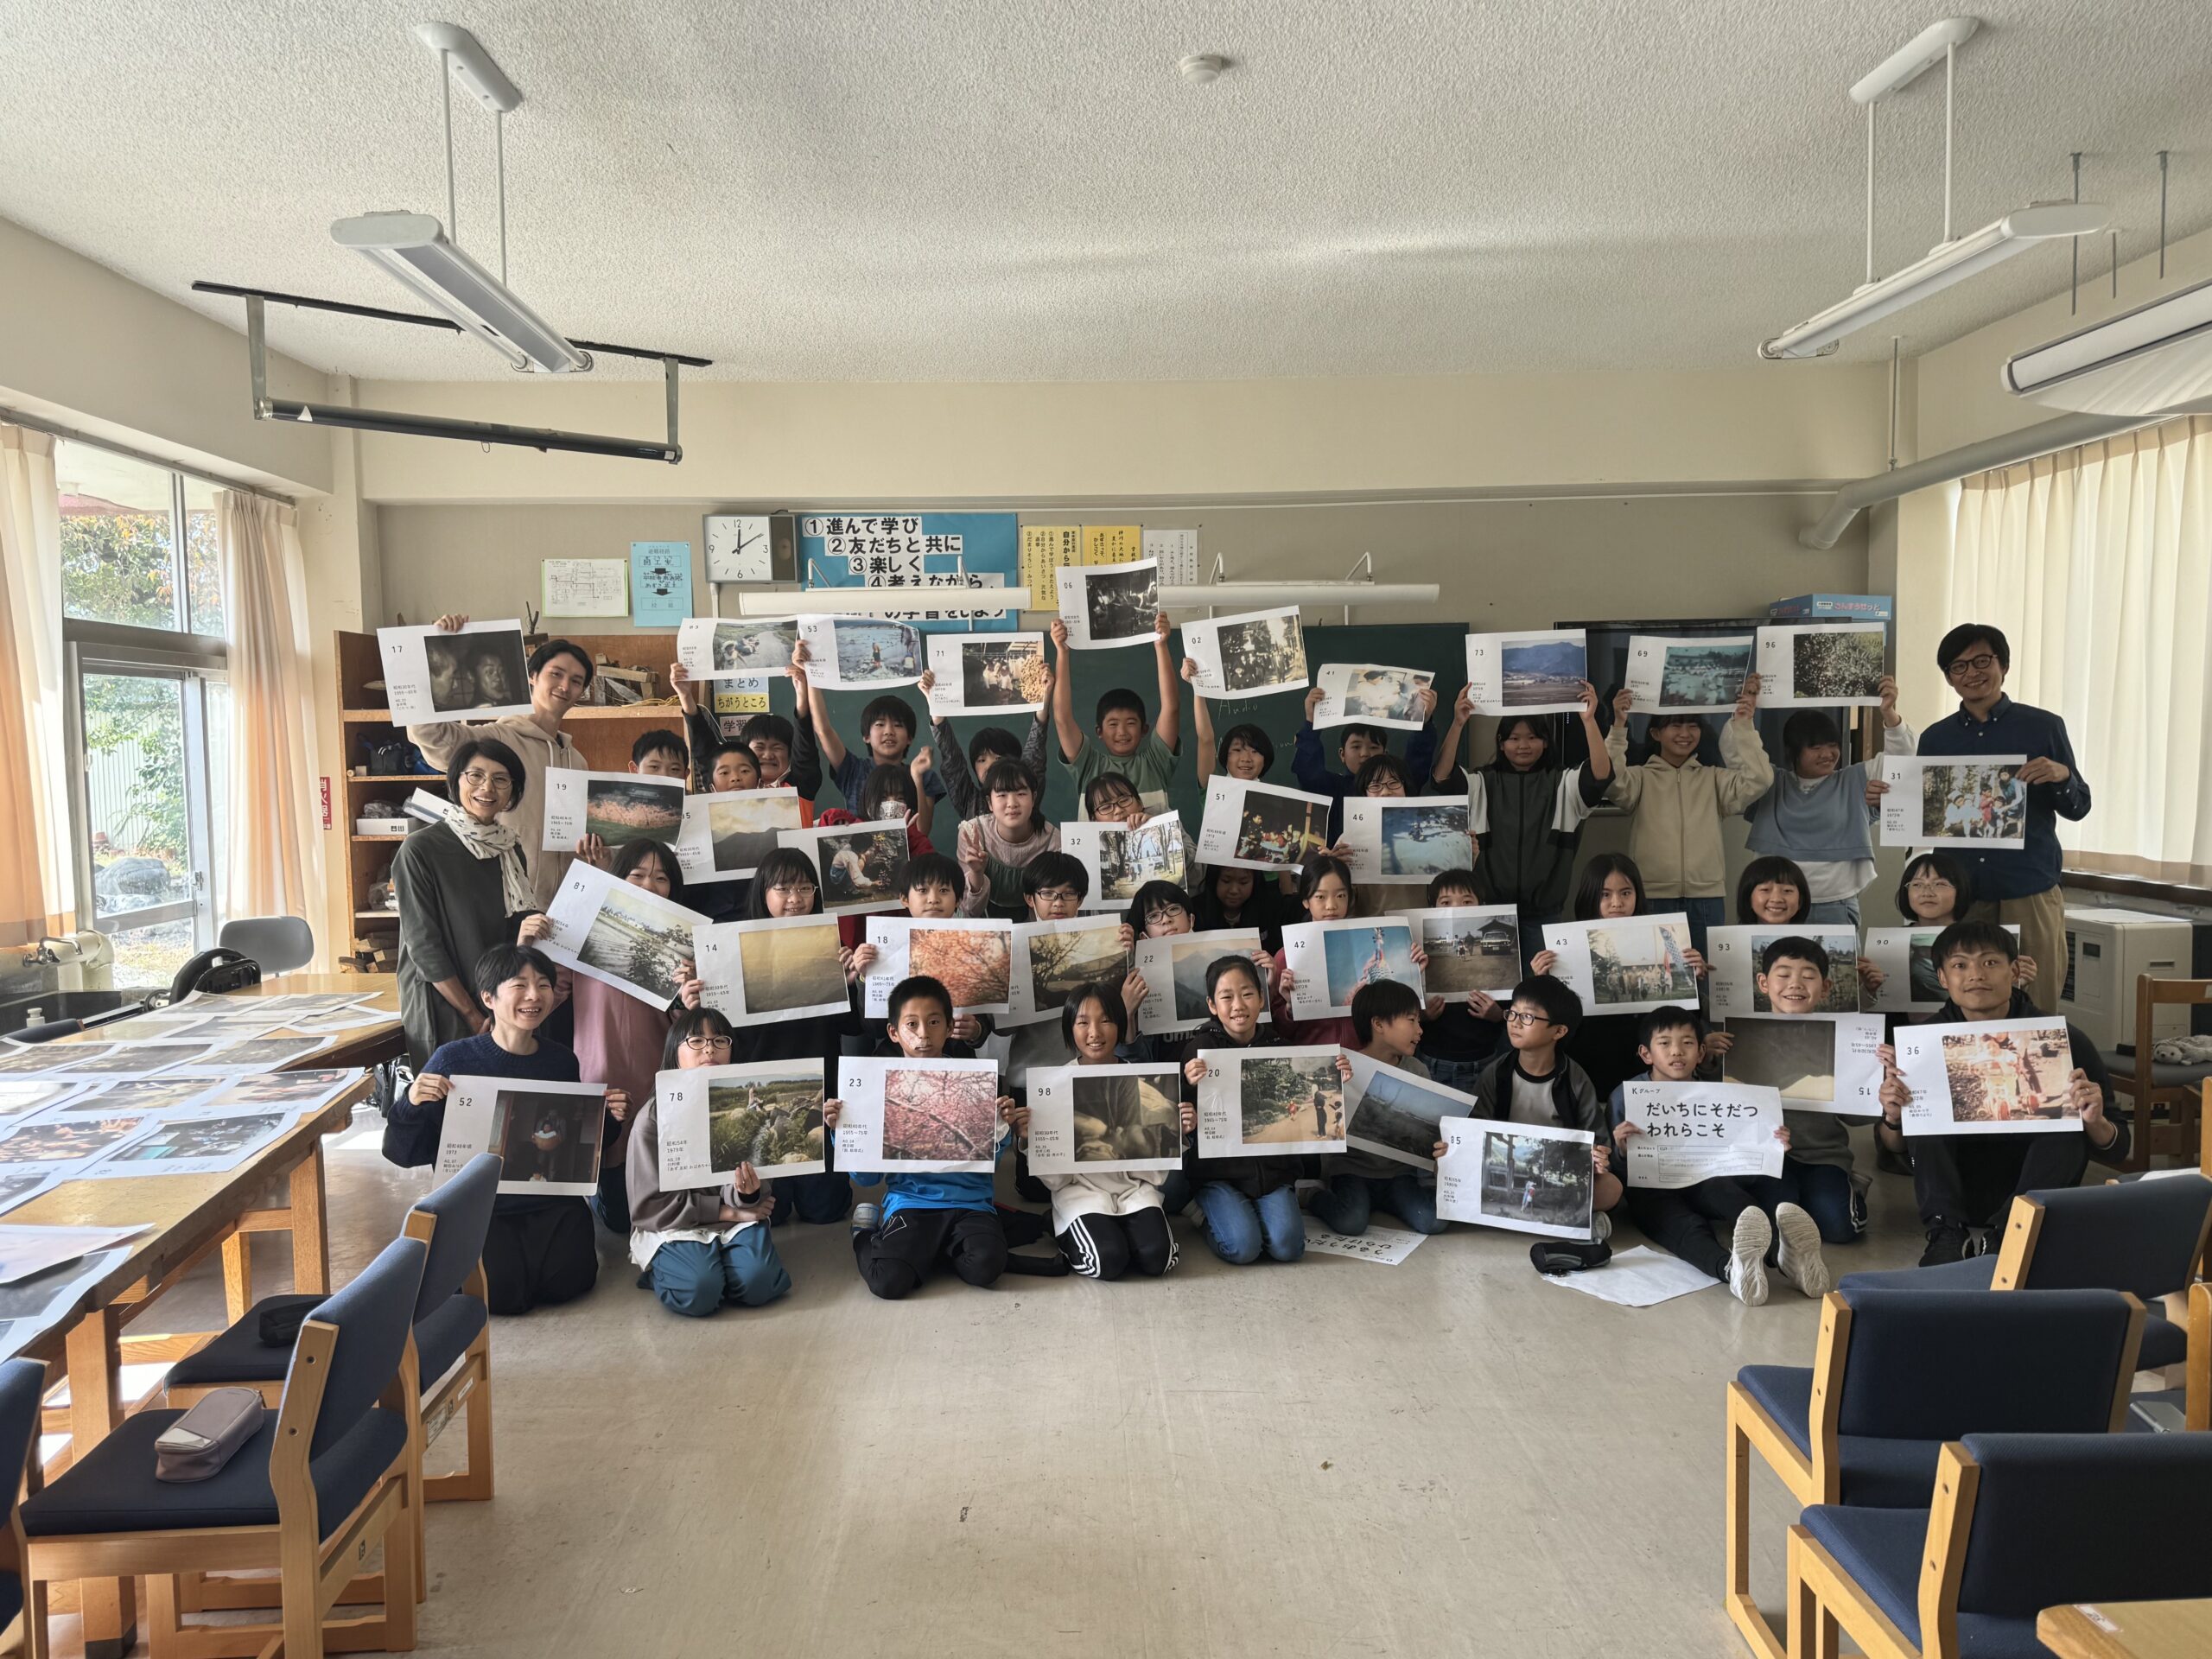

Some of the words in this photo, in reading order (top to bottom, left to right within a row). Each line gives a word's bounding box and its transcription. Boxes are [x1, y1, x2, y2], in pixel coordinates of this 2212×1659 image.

[734, 519, 741, 528] 12
[849, 556, 920, 574] ③楽しく
[737, 569, 743, 579] 6
[1192, 636, 1201, 645] 02
[391, 645, 403, 653] 17
[718, 697, 766, 709] ちがうところ
[574, 881, 586, 892] 81
[706, 944, 717, 952] 14
[1294, 940, 1305, 949] 42
[1144, 955, 1154, 963] 22
[1907, 1046, 1920, 1056] 36
[1208, 1069, 1220, 1077] 20
[849, 1078, 861, 1087] 23
[1038, 1087, 1051, 1096] 98
[1859, 1087, 1871, 1096] 15
[669, 1092, 683, 1102] 78
[459, 1097, 473, 1107] 52
[1646, 1102, 1758, 1118] だいちにそだつ
[1647, 1123, 1726, 1138] われらこそ
[1451, 1135, 1461, 1145] 85
